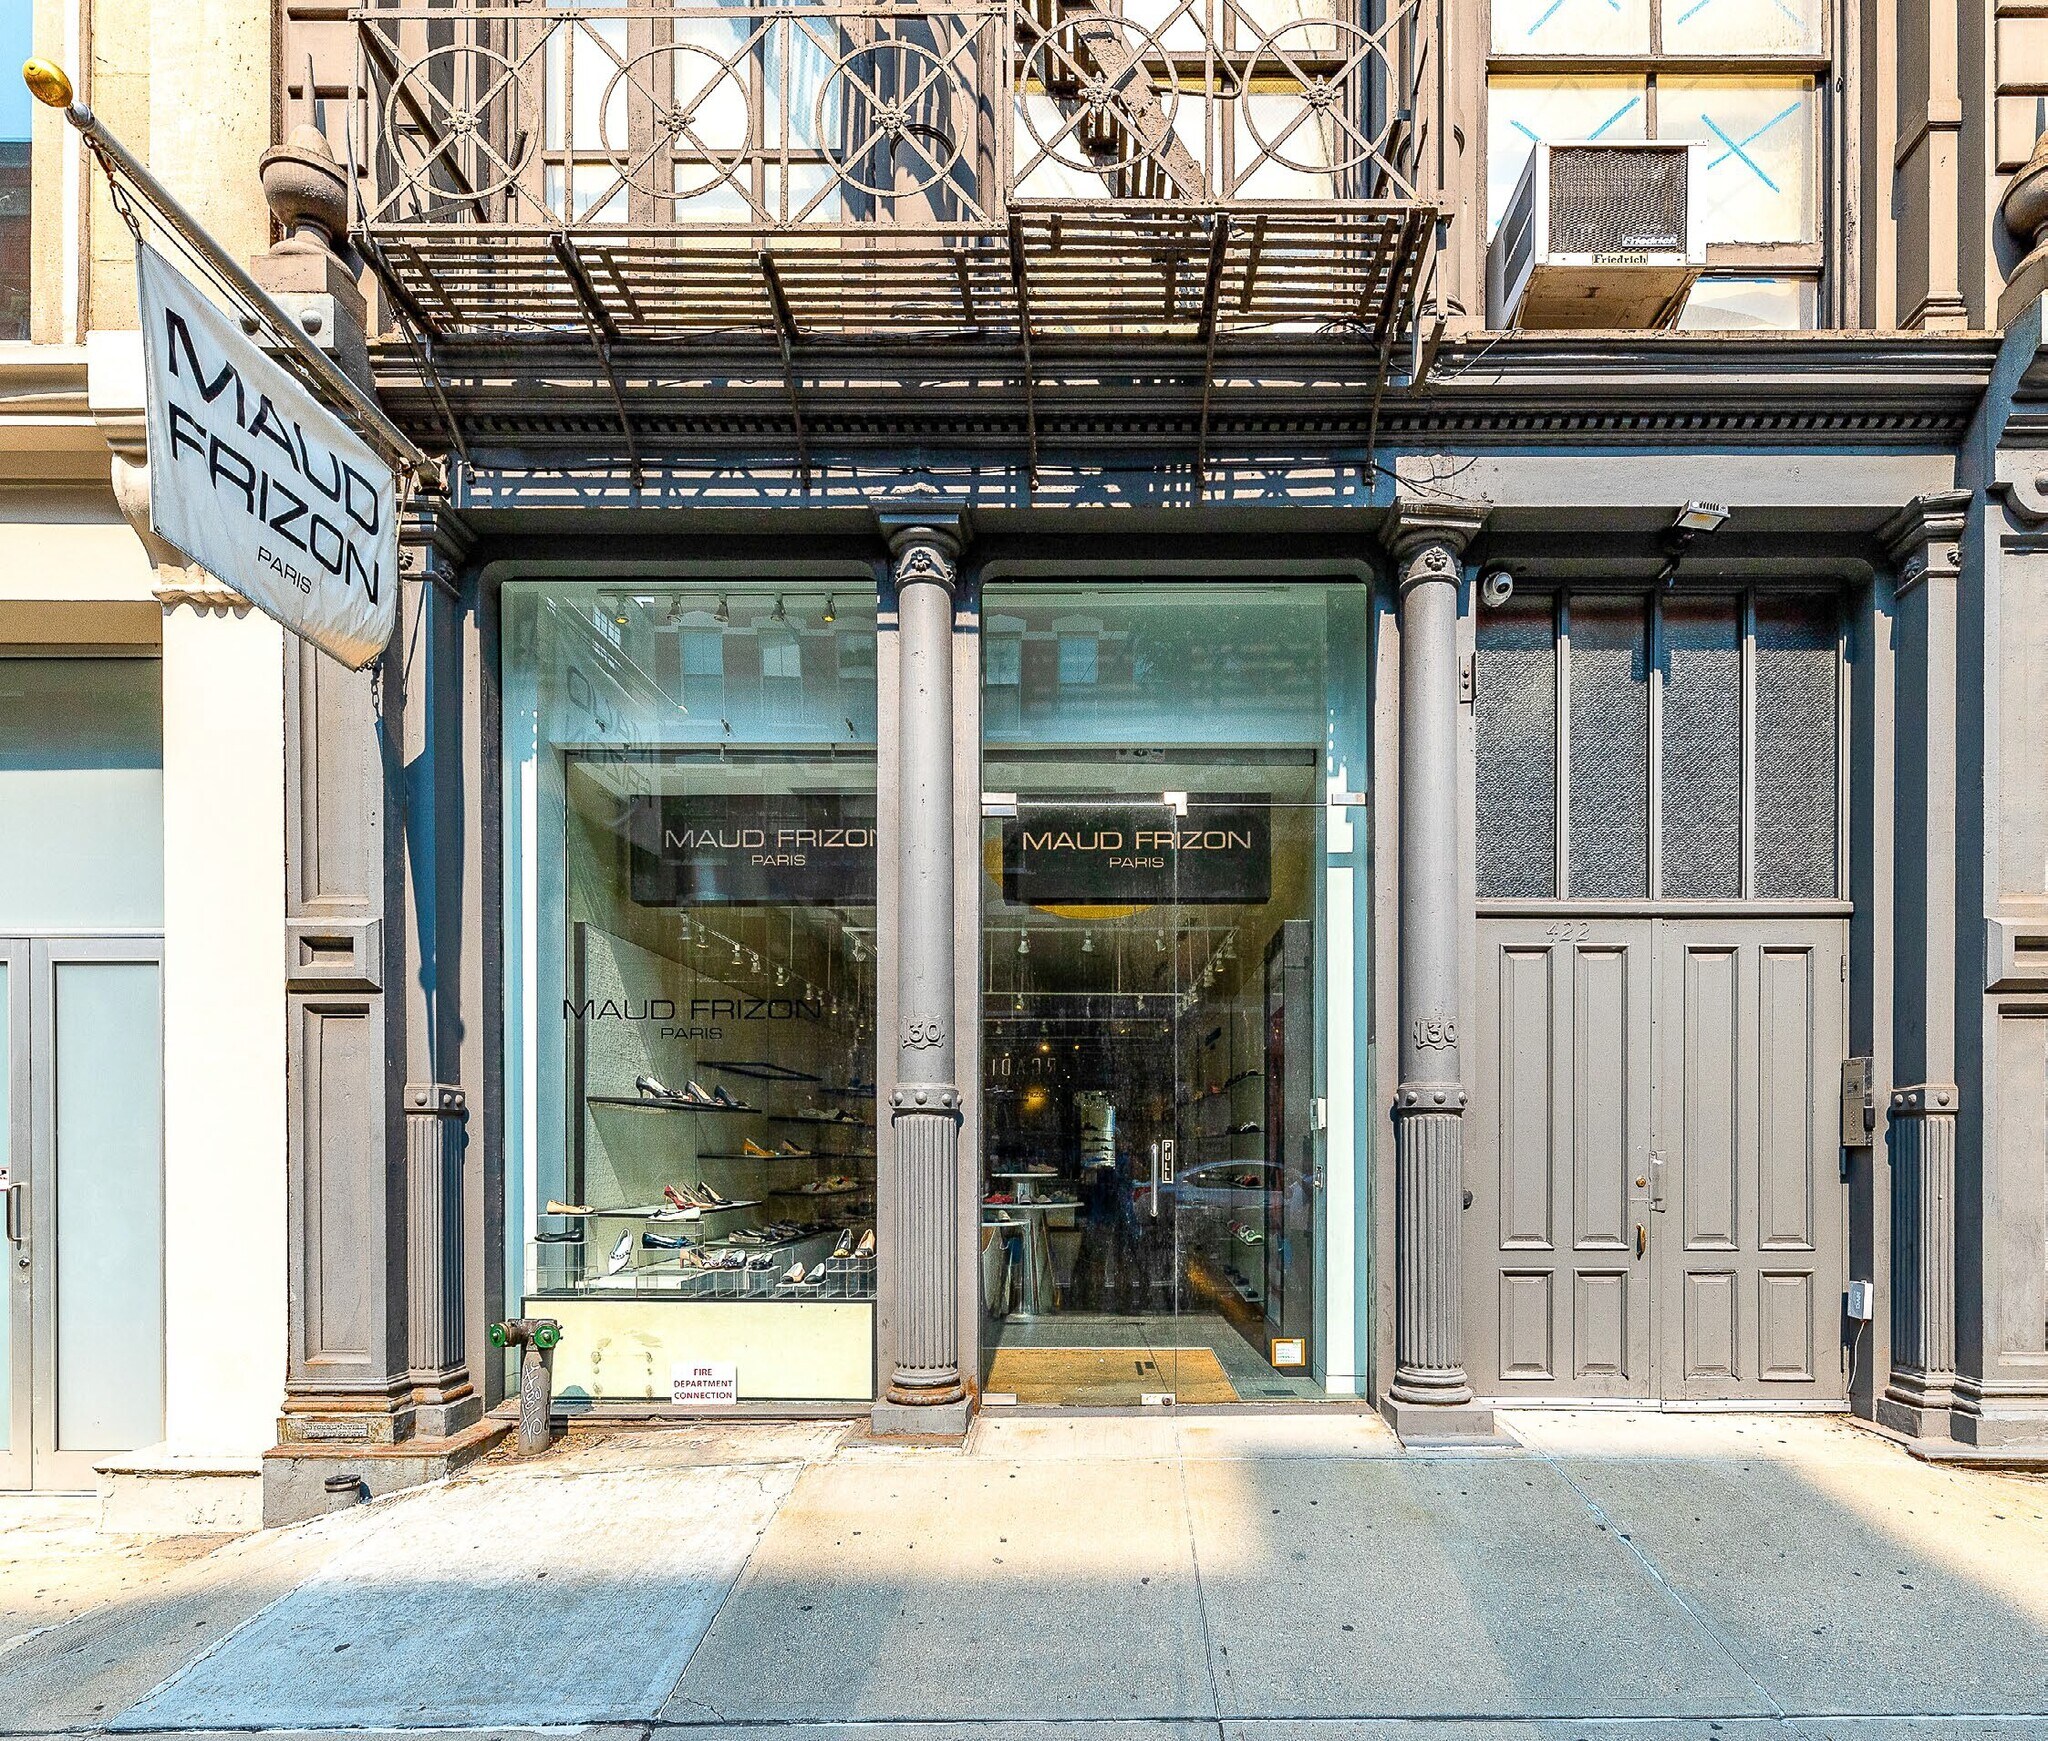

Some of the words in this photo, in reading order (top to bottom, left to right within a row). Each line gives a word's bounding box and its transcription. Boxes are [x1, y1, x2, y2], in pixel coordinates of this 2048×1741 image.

[1593, 253, 1647, 264] Friedrich
[165, 307, 380, 536] MAUD
[168, 400, 379, 606] FRIZON
[257, 545, 312, 595] PARIS
[665, 829, 765, 848] MAUD
[1022, 831, 1122, 850] MAUD
[1135, 830, 1251, 850] FRIZON
[751, 854, 806, 867] PARIS
[1109, 856, 1165, 869] PARIS
[1545, 922, 1590, 943] 422
[562, 999, 675, 1020] MAUD
[690, 999, 821, 1020] FRIZON
[660, 1027, 723, 1040] PARIS
[1419, 1021, 1457, 1044] 130
[693, 1368, 713, 1376] FIRE
[673, 1380, 733, 1388] DEPARTMENT
[673, 1391, 733, 1400] CONNECTION
